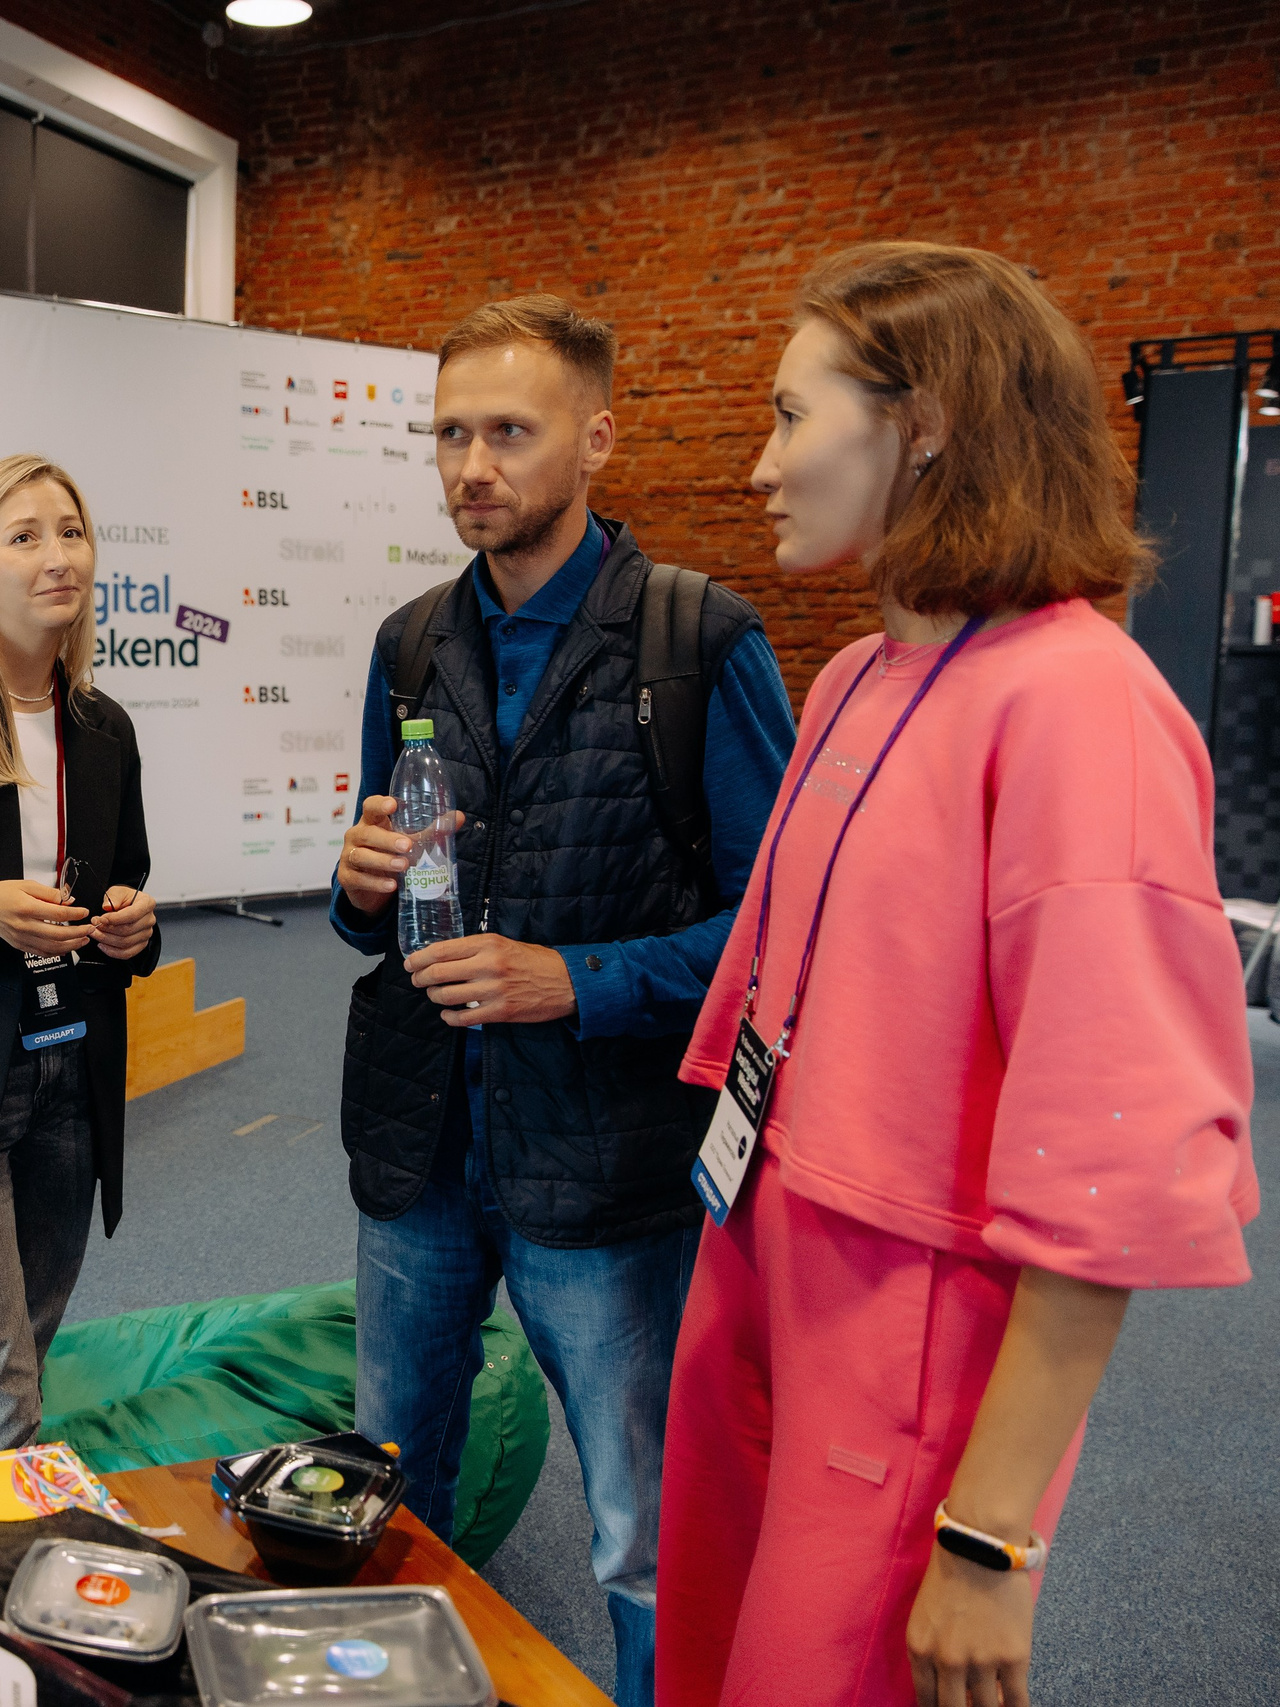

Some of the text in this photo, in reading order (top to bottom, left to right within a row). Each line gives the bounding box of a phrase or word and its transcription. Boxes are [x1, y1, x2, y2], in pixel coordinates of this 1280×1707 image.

[257, 490, 289, 509] BSL
[95, 525, 170, 546] AGLINE
[94, 572, 170, 625] gital
[258, 589, 290, 606] BSL
[181, 609, 222, 639] 2024
[93, 629, 199, 667] ekend
[258, 686, 290, 703] BSL
[405, 874, 450, 889] родник
[25, 955, 61, 969] Weekend
[34, 1028, 75, 1045] СТАНДАРТ
[697, 1171, 721, 1213] СТАНДАРТ
